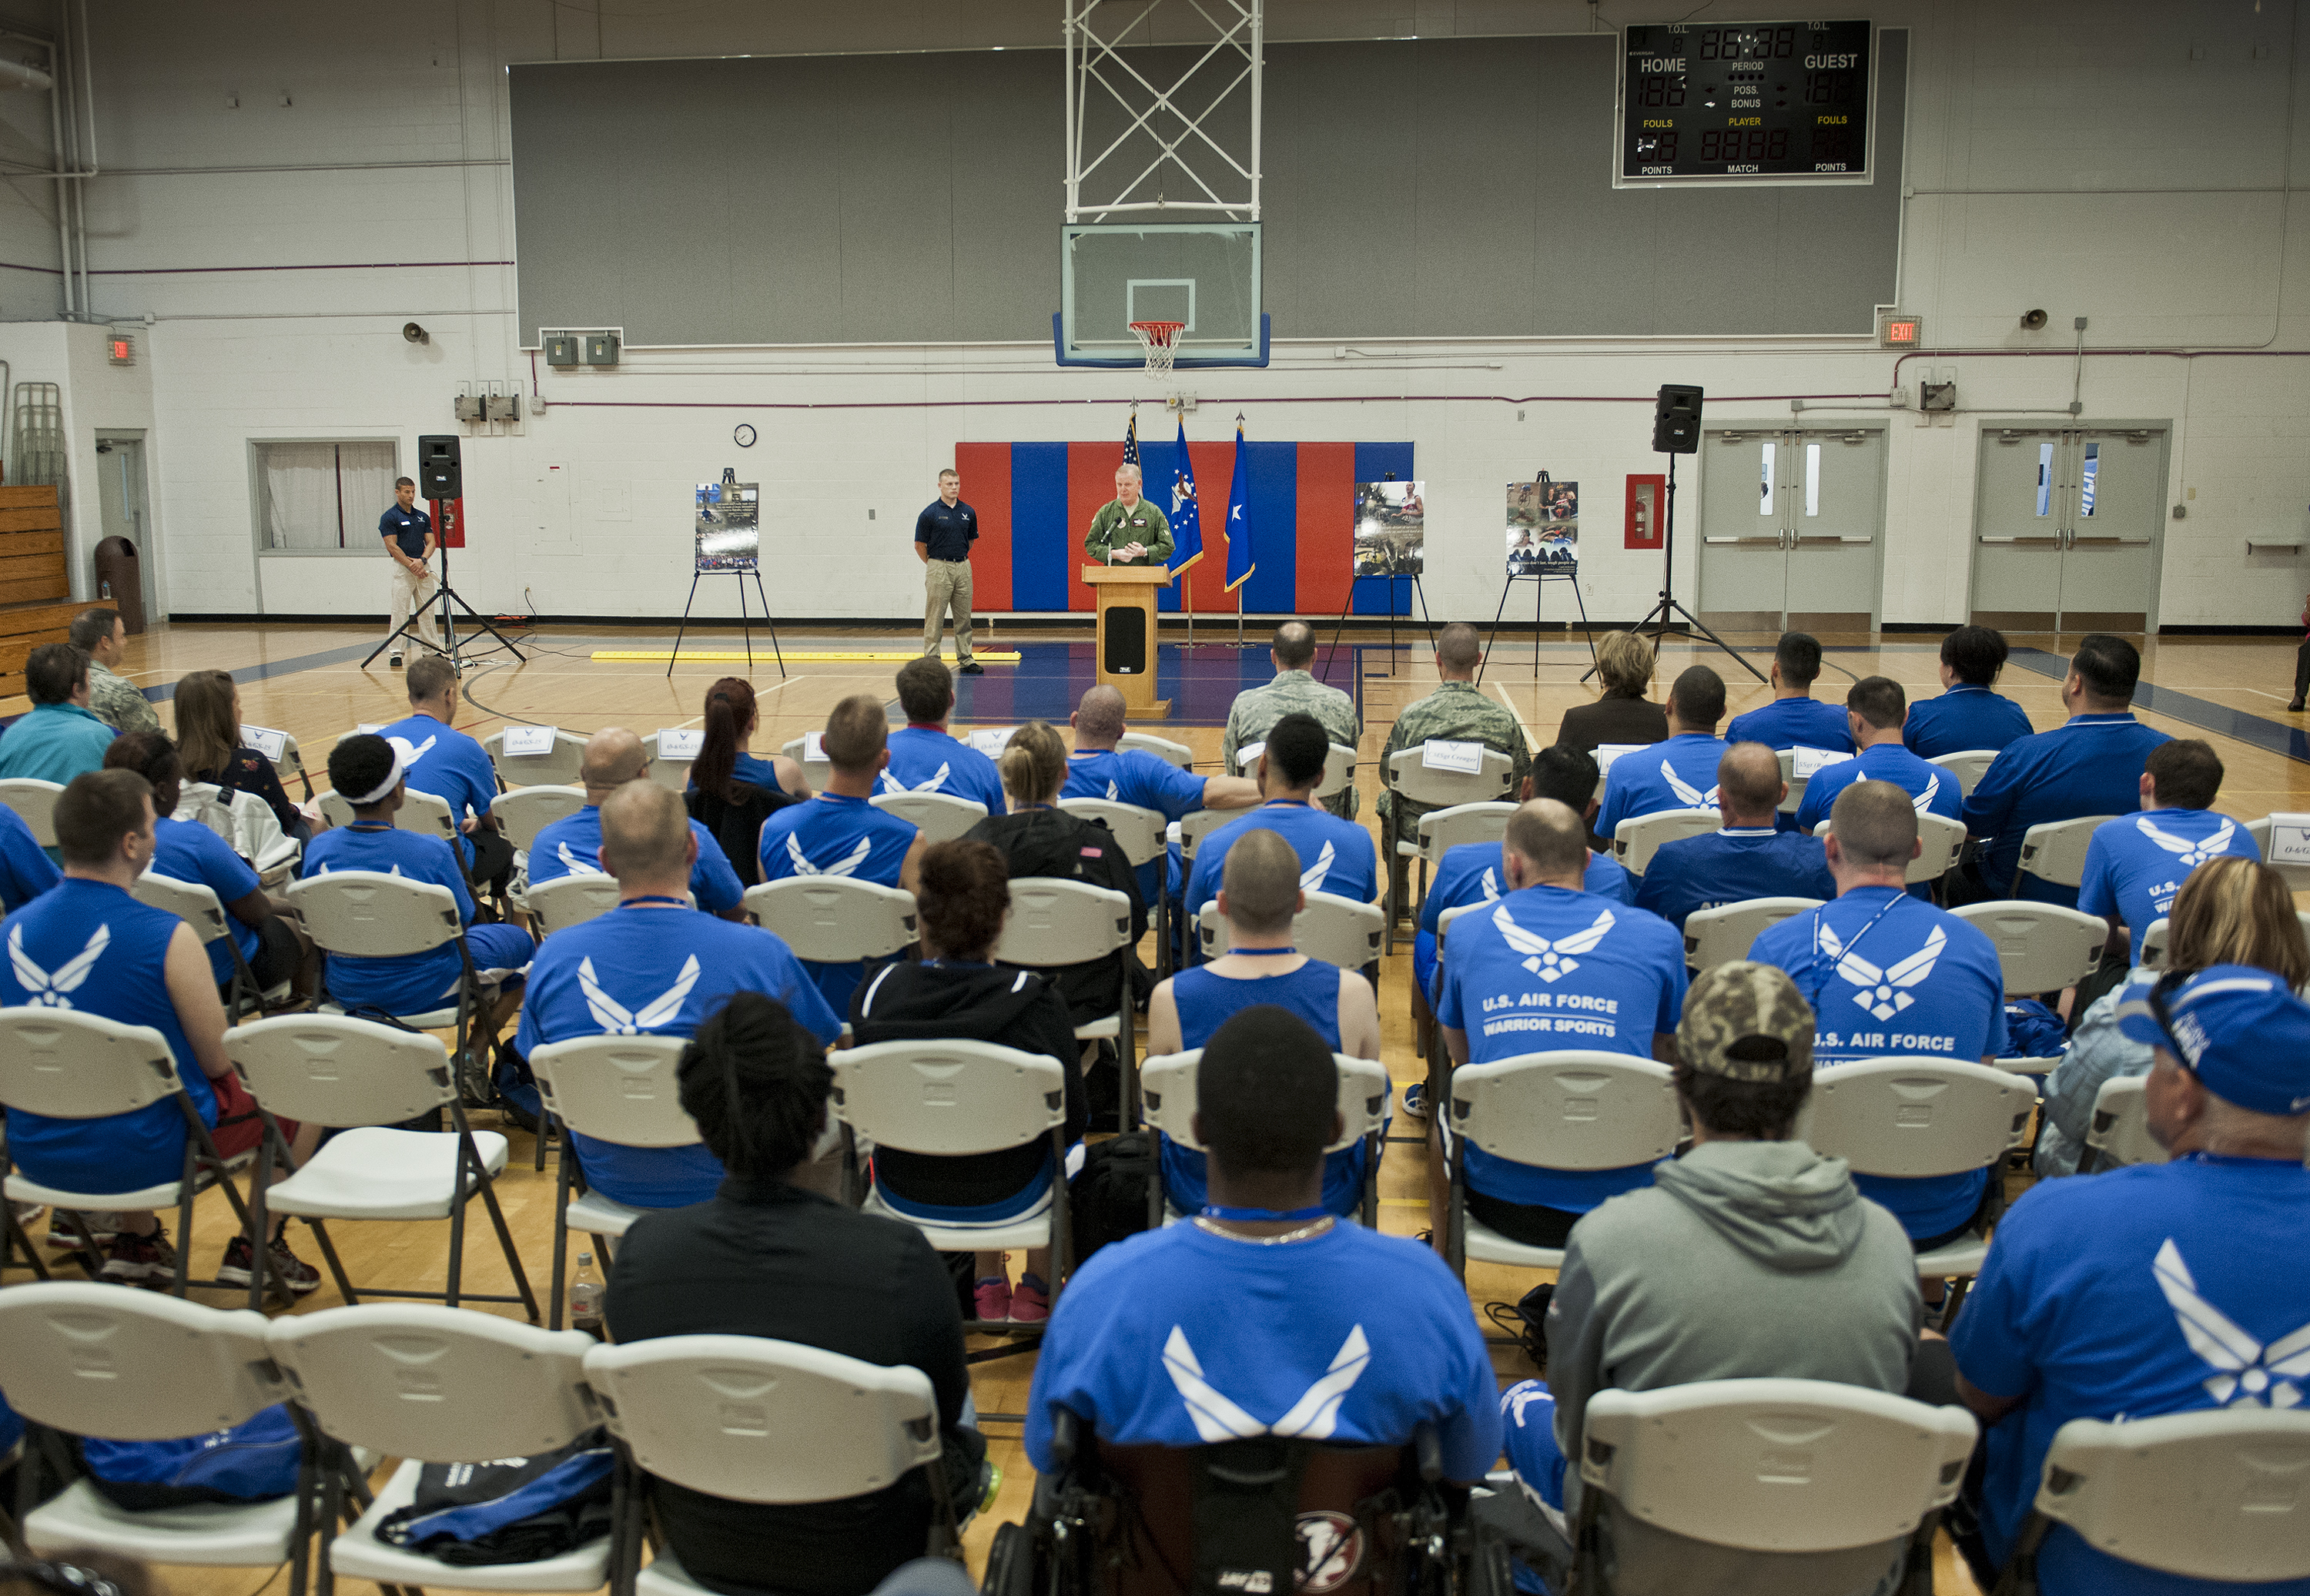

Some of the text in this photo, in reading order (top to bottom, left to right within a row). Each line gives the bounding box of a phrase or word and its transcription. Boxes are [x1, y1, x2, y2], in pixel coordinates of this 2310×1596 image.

[1667, 25, 1689, 33] T.O.L.
[1807, 21, 1830, 30] T.O.L.
[1641, 58, 1686, 72] HOME
[1732, 62, 1764, 71] PERIOD
[1805, 54, 1858, 69] GUEST
[1734, 85, 1759, 95] POSS.
[1731, 99, 1761, 108] BONUS
[1643, 119, 1673, 128] FOULS
[1728, 117, 1761, 125] PLAYER
[1817, 115, 1847, 125] FOULS
[1642, 166, 1672, 174] POINTS
[1727, 164, 1759, 173] MATCH
[1816, 162, 1846, 172] POINTS
[1891, 323, 1914, 340] EXIT
[2148, 881, 2181, 897] U.S.
[1483, 993, 1619, 1015] U.S. AIR FORCE
[1483, 1019, 1616, 1038] WARRIOR SPORTS
[1850, 1032, 1885, 1047] AIR
[1890, 1034, 1956, 1051] FORCE
